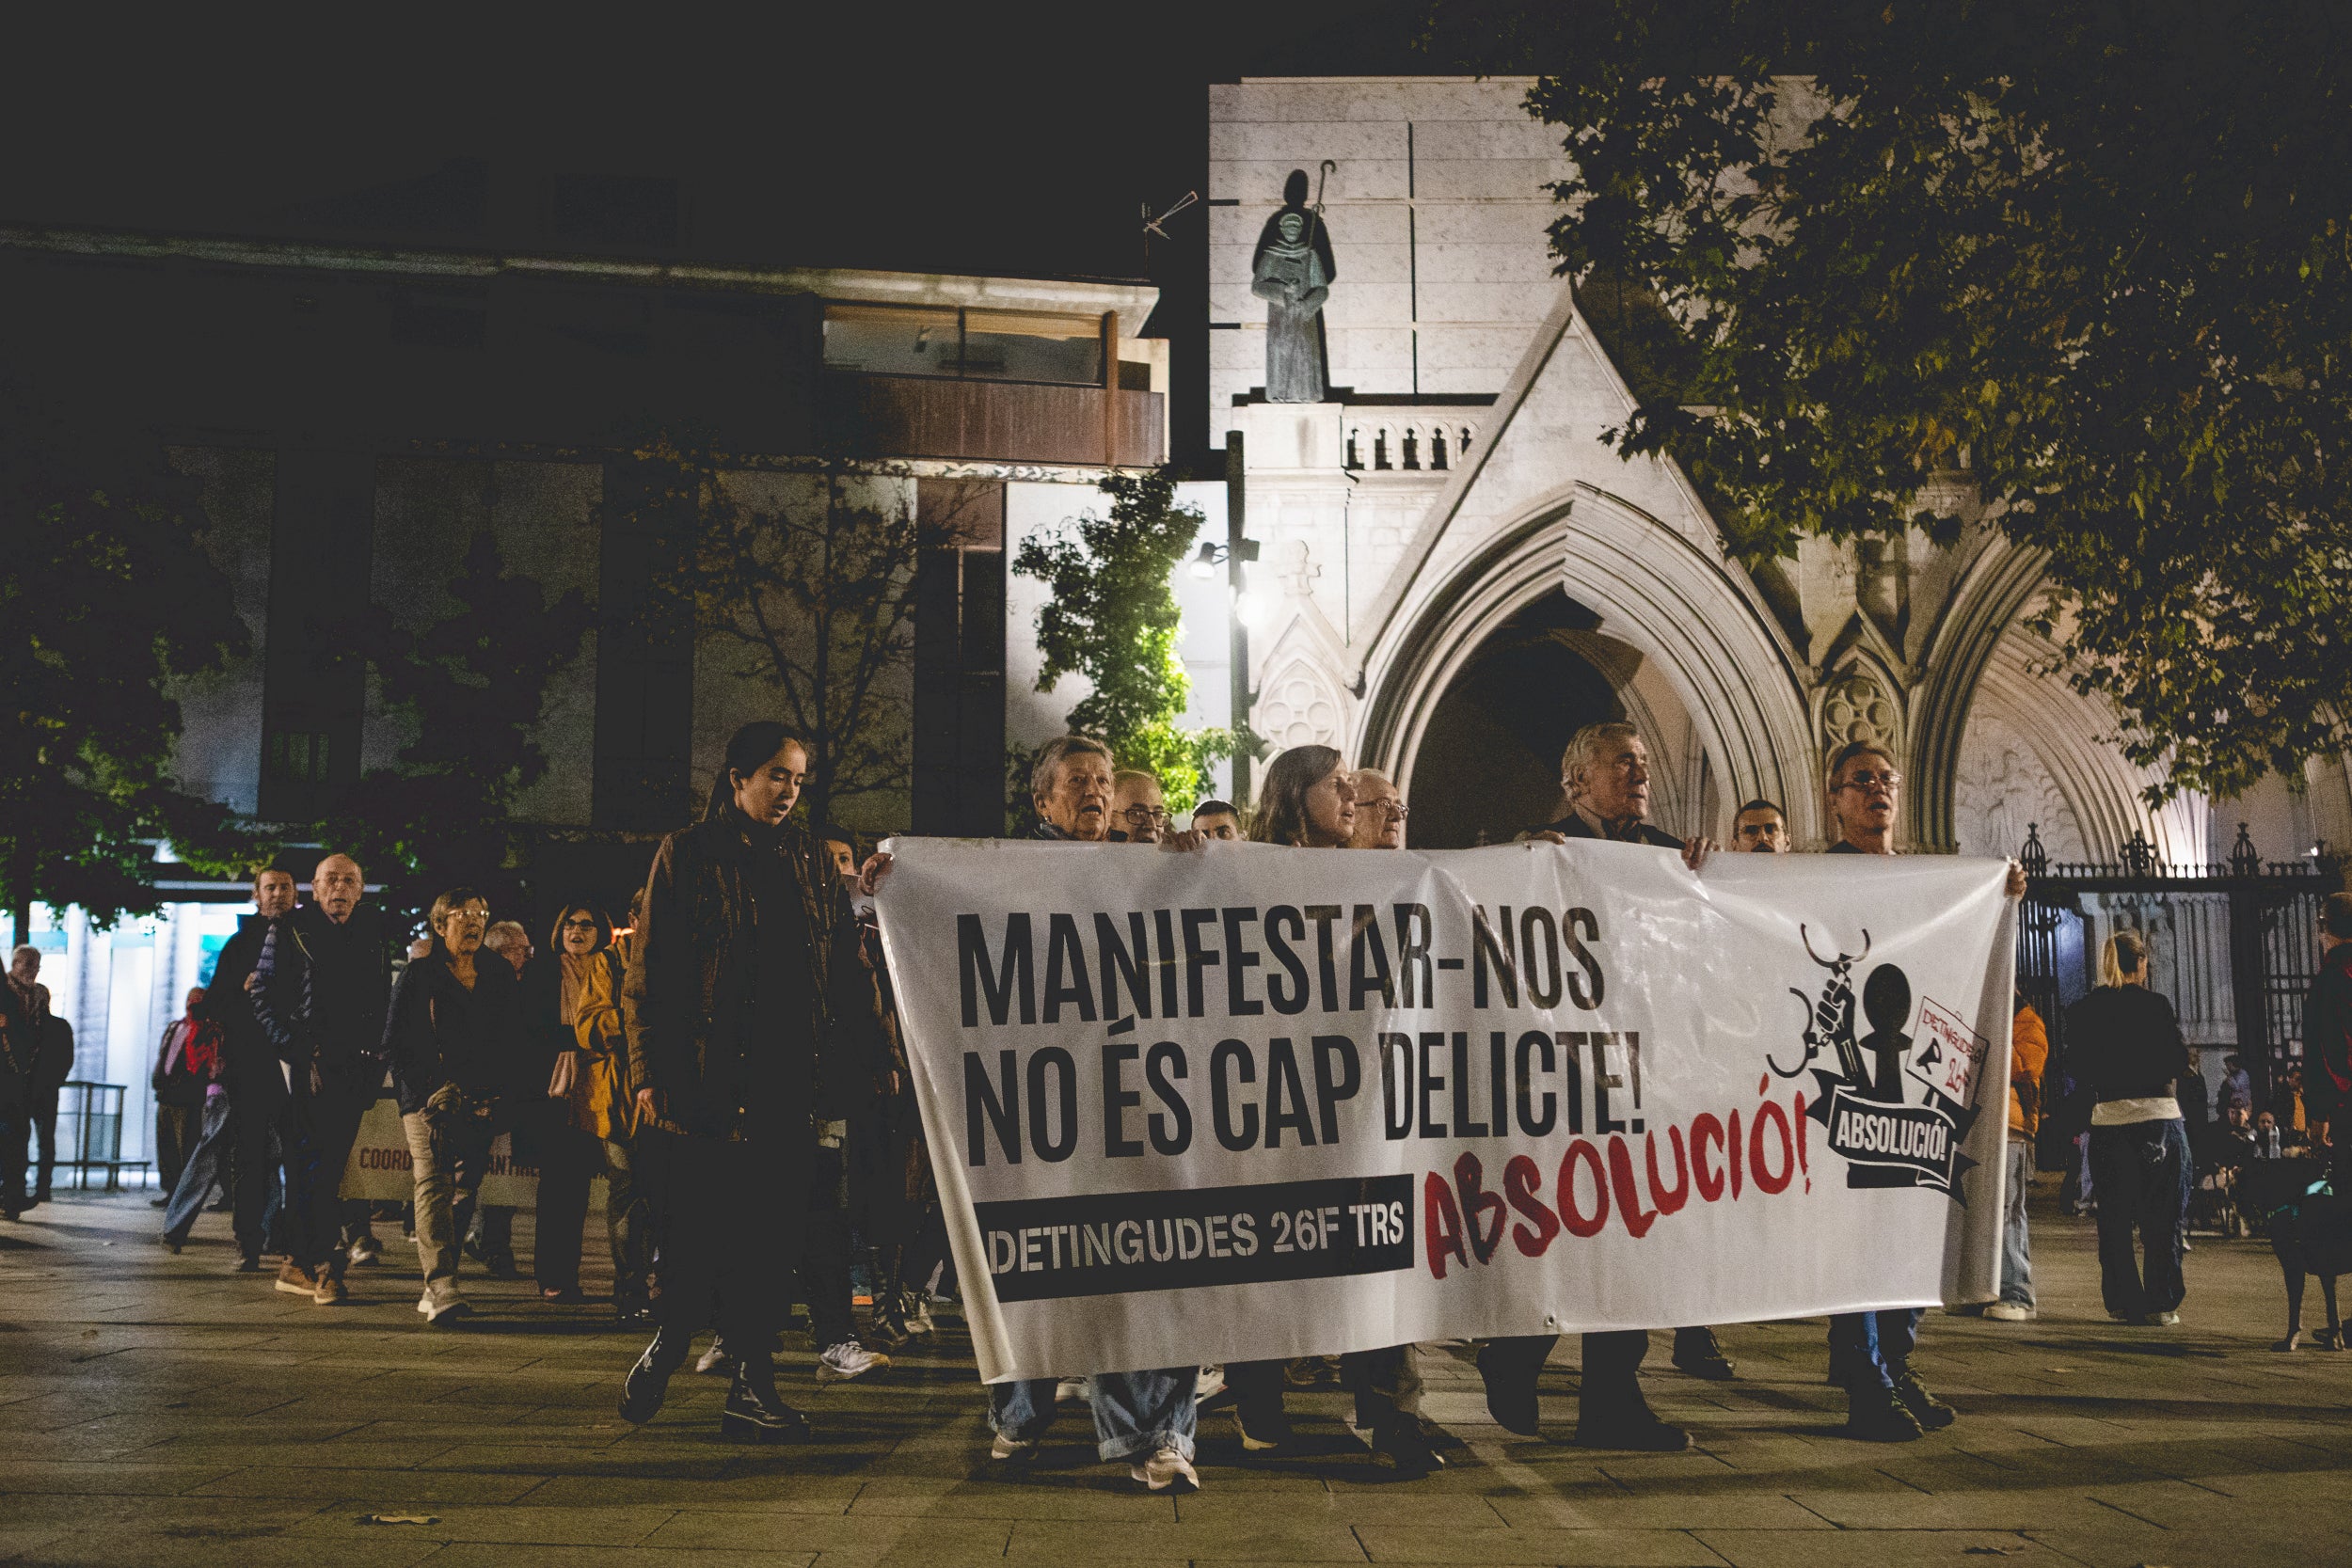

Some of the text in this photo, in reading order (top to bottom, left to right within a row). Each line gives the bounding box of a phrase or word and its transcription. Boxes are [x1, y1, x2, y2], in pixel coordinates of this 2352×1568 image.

[956, 902, 1605, 1028] MANIFESTAR-NOS
[962, 1014, 1646, 1167] NO ÉS CAP DELICTE!
[1836, 1110, 1947, 1162] ABSOLUCIÓ!
[987, 1200, 1405, 1275] DETINGUDES 26F TRS
[1424, 1071, 1812, 1281] ABSOLUCIÓ!
